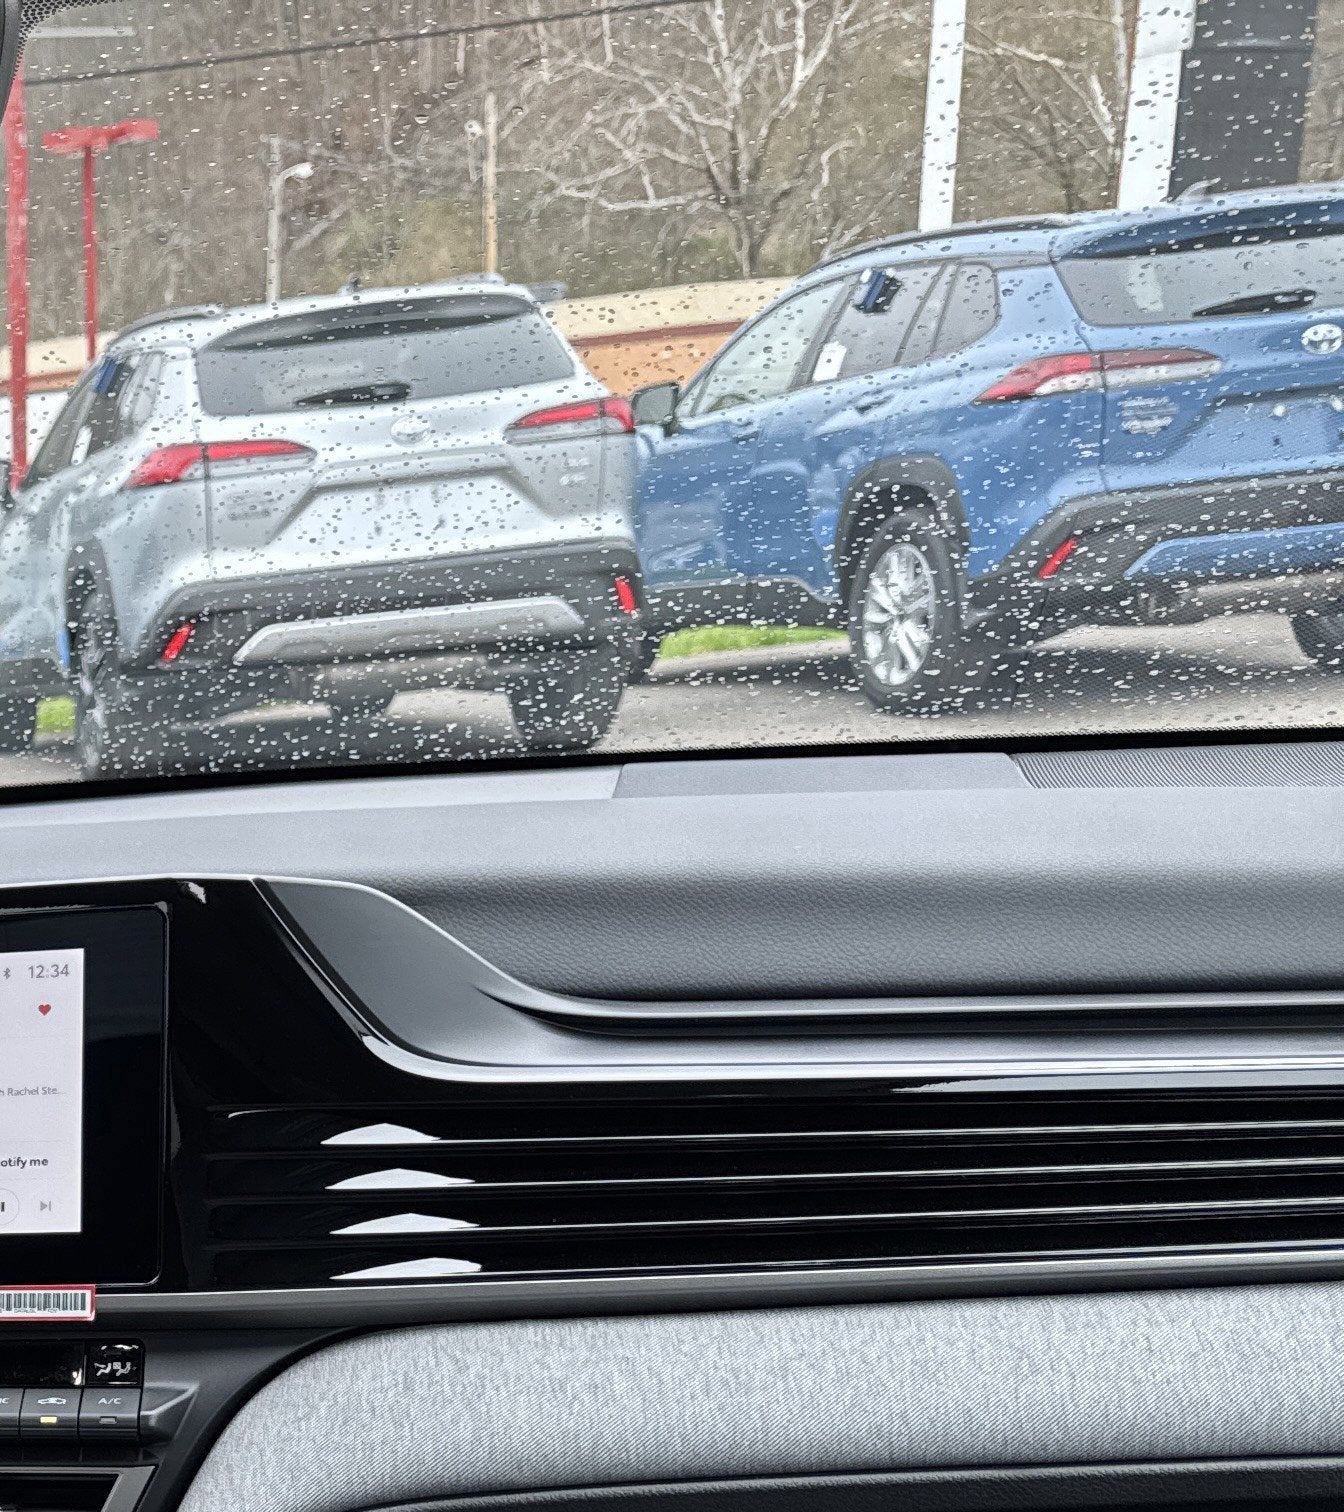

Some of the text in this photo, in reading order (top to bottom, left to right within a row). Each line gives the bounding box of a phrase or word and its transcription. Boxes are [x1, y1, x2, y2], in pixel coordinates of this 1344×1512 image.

[28, 964, 70, 979] 12:34
[7, 1087, 40, 1097] Rachel
[29, 1158, 49, 1167] me
[98, 1397, 121, 1405] A/C
